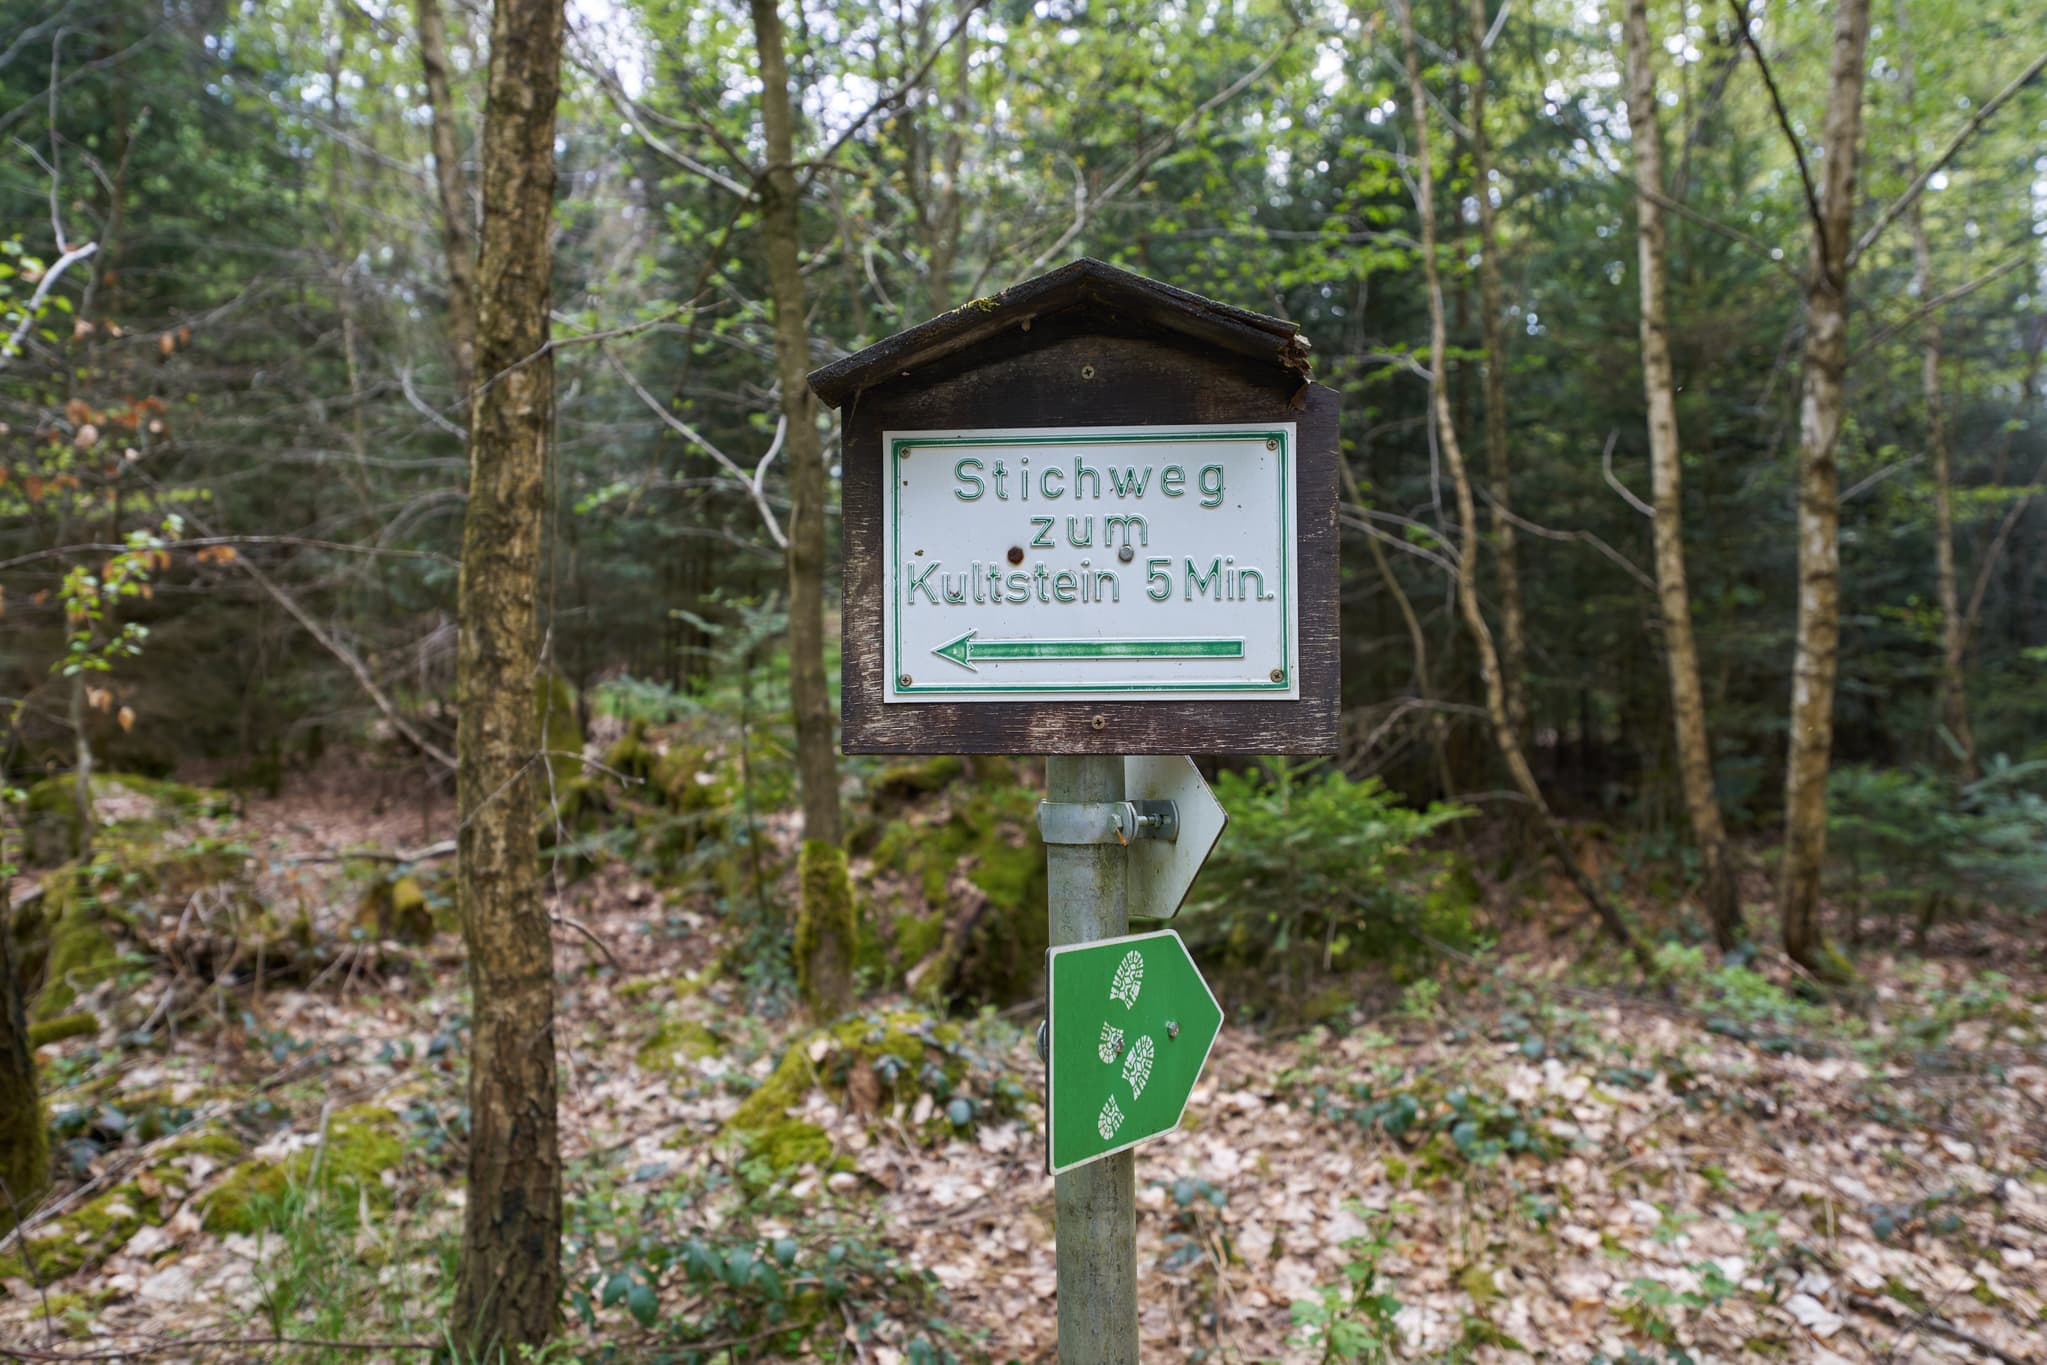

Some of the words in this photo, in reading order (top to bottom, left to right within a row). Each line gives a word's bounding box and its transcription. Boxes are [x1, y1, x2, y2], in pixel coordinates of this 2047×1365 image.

[954, 456, 1225, 508] Stichweg
[1030, 513, 1149, 547] zum
[907, 559, 1120, 604] Kultstein
[1146, 556, 1173, 601] 5
[1184, 556, 1274, 601] Min.
